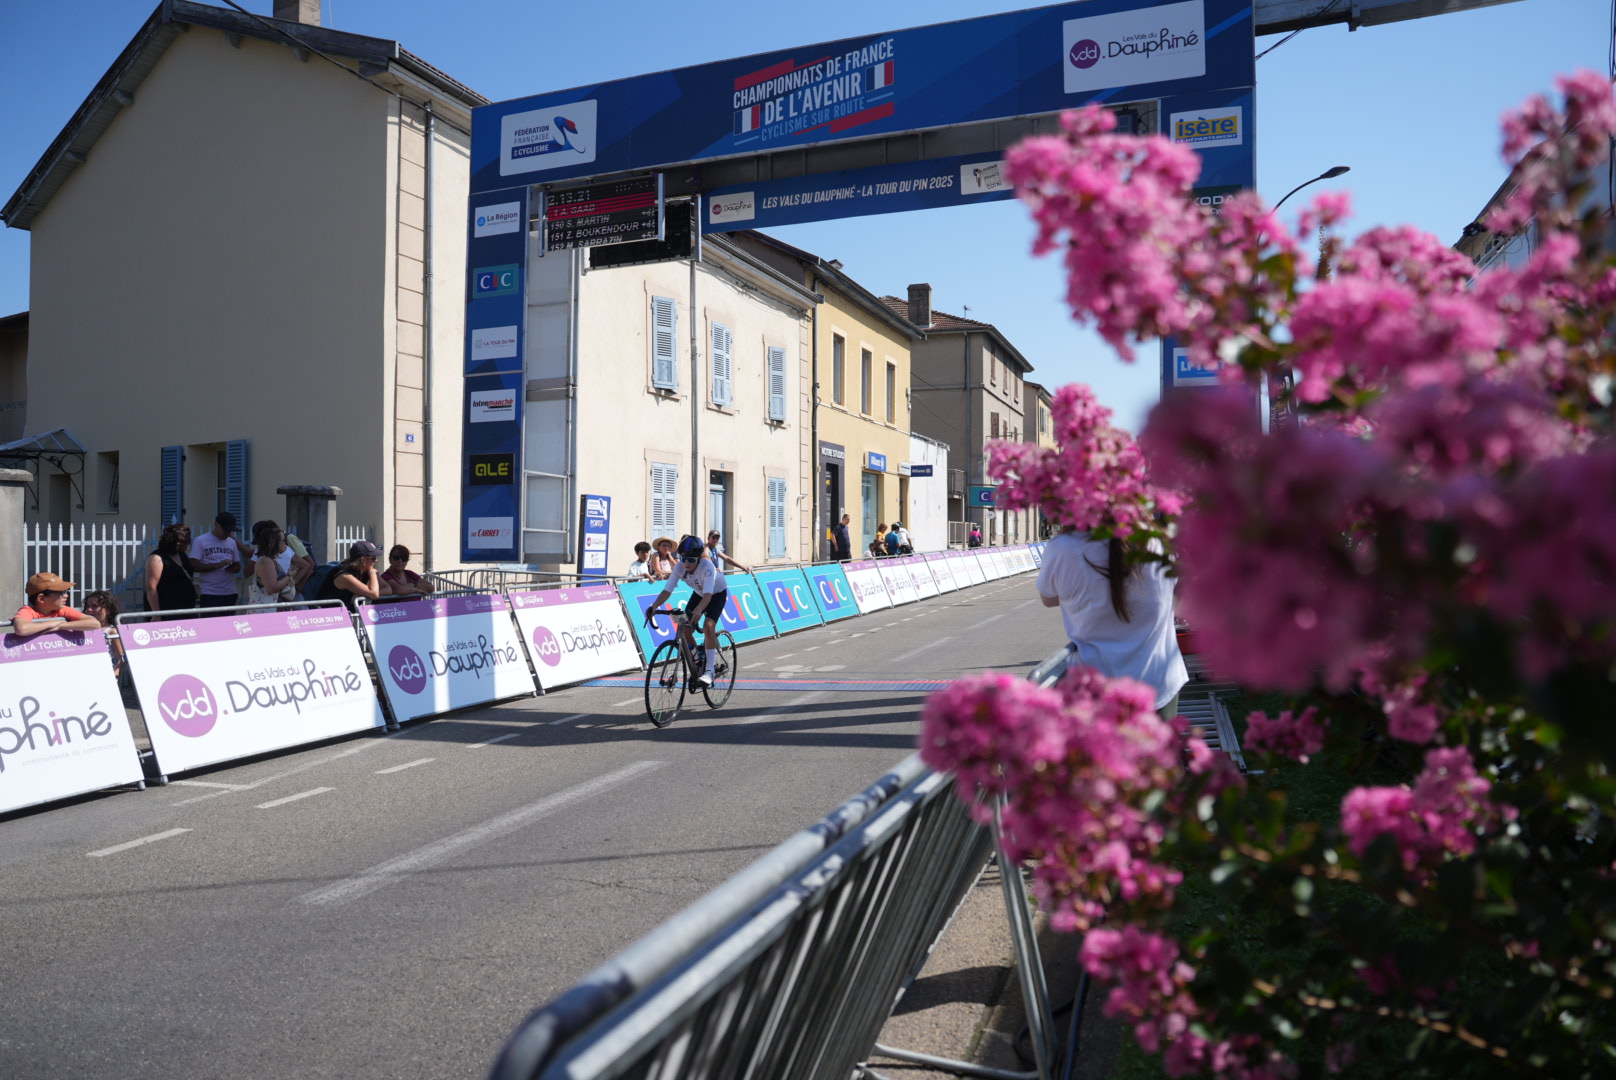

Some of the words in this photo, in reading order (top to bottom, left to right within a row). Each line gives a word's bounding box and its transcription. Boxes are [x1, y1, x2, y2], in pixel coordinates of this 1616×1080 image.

[1071, 45, 1098, 61] vdd
[733, 64, 823, 109] CHAMPIONNATS
[826, 56, 842, 78] DE
[845, 38, 894, 72] FRANCE
[764, 97, 784, 126] DE
[789, 72, 862, 118] L'AVENIR
[761, 114, 808, 142] CYCLISME
[811, 108, 830, 126] SUR
[834, 97, 865, 118] ROUTE
[1178, 116, 1234, 137] isère
[513, 133, 549, 145] FRANÇAISE
[514, 124, 550, 137] FÉDÉRATION
[1185, 134, 1237, 143] DÉPARTEMENT
[518, 144, 549, 156] CYCLISME
[762, 196, 778, 209] LES
[780, 193, 800, 207] VALS
[801, 192, 813, 205] DU
[814, 184, 856, 203] DAUPHINÉ
[862, 184, 873, 197] LA
[875, 181, 897, 196] TOUR
[899, 179, 912, 192] DU
[912, 178, 929, 191] PIN
[929, 174, 954, 189] 2025
[495, 212, 518, 221] Région
[576, 214, 610, 228] MARTIN
[576, 222, 640, 239] BOUKENDOUR
[480, 272, 511, 289] CIC
[472, 398, 514, 408] Intermarché
[774, 584, 809, 614] CIC
[819, 578, 848, 604] CIC
[310, 617, 325, 625] TOUR
[24, 643, 36, 652] LA
[38, 640, 63, 650] TOUR
[65, 638, 78, 647] DU
[80, 637, 94, 645] PIN
[534, 635, 560, 656] vdd
[247, 669, 267, 682] Les
[267, 665, 286, 679] Vals
[286, 664, 300, 677] du
[389, 656, 424, 681] vdd
[160, 687, 214, 721] vdd
[0, 695, 112, 774] phiné
